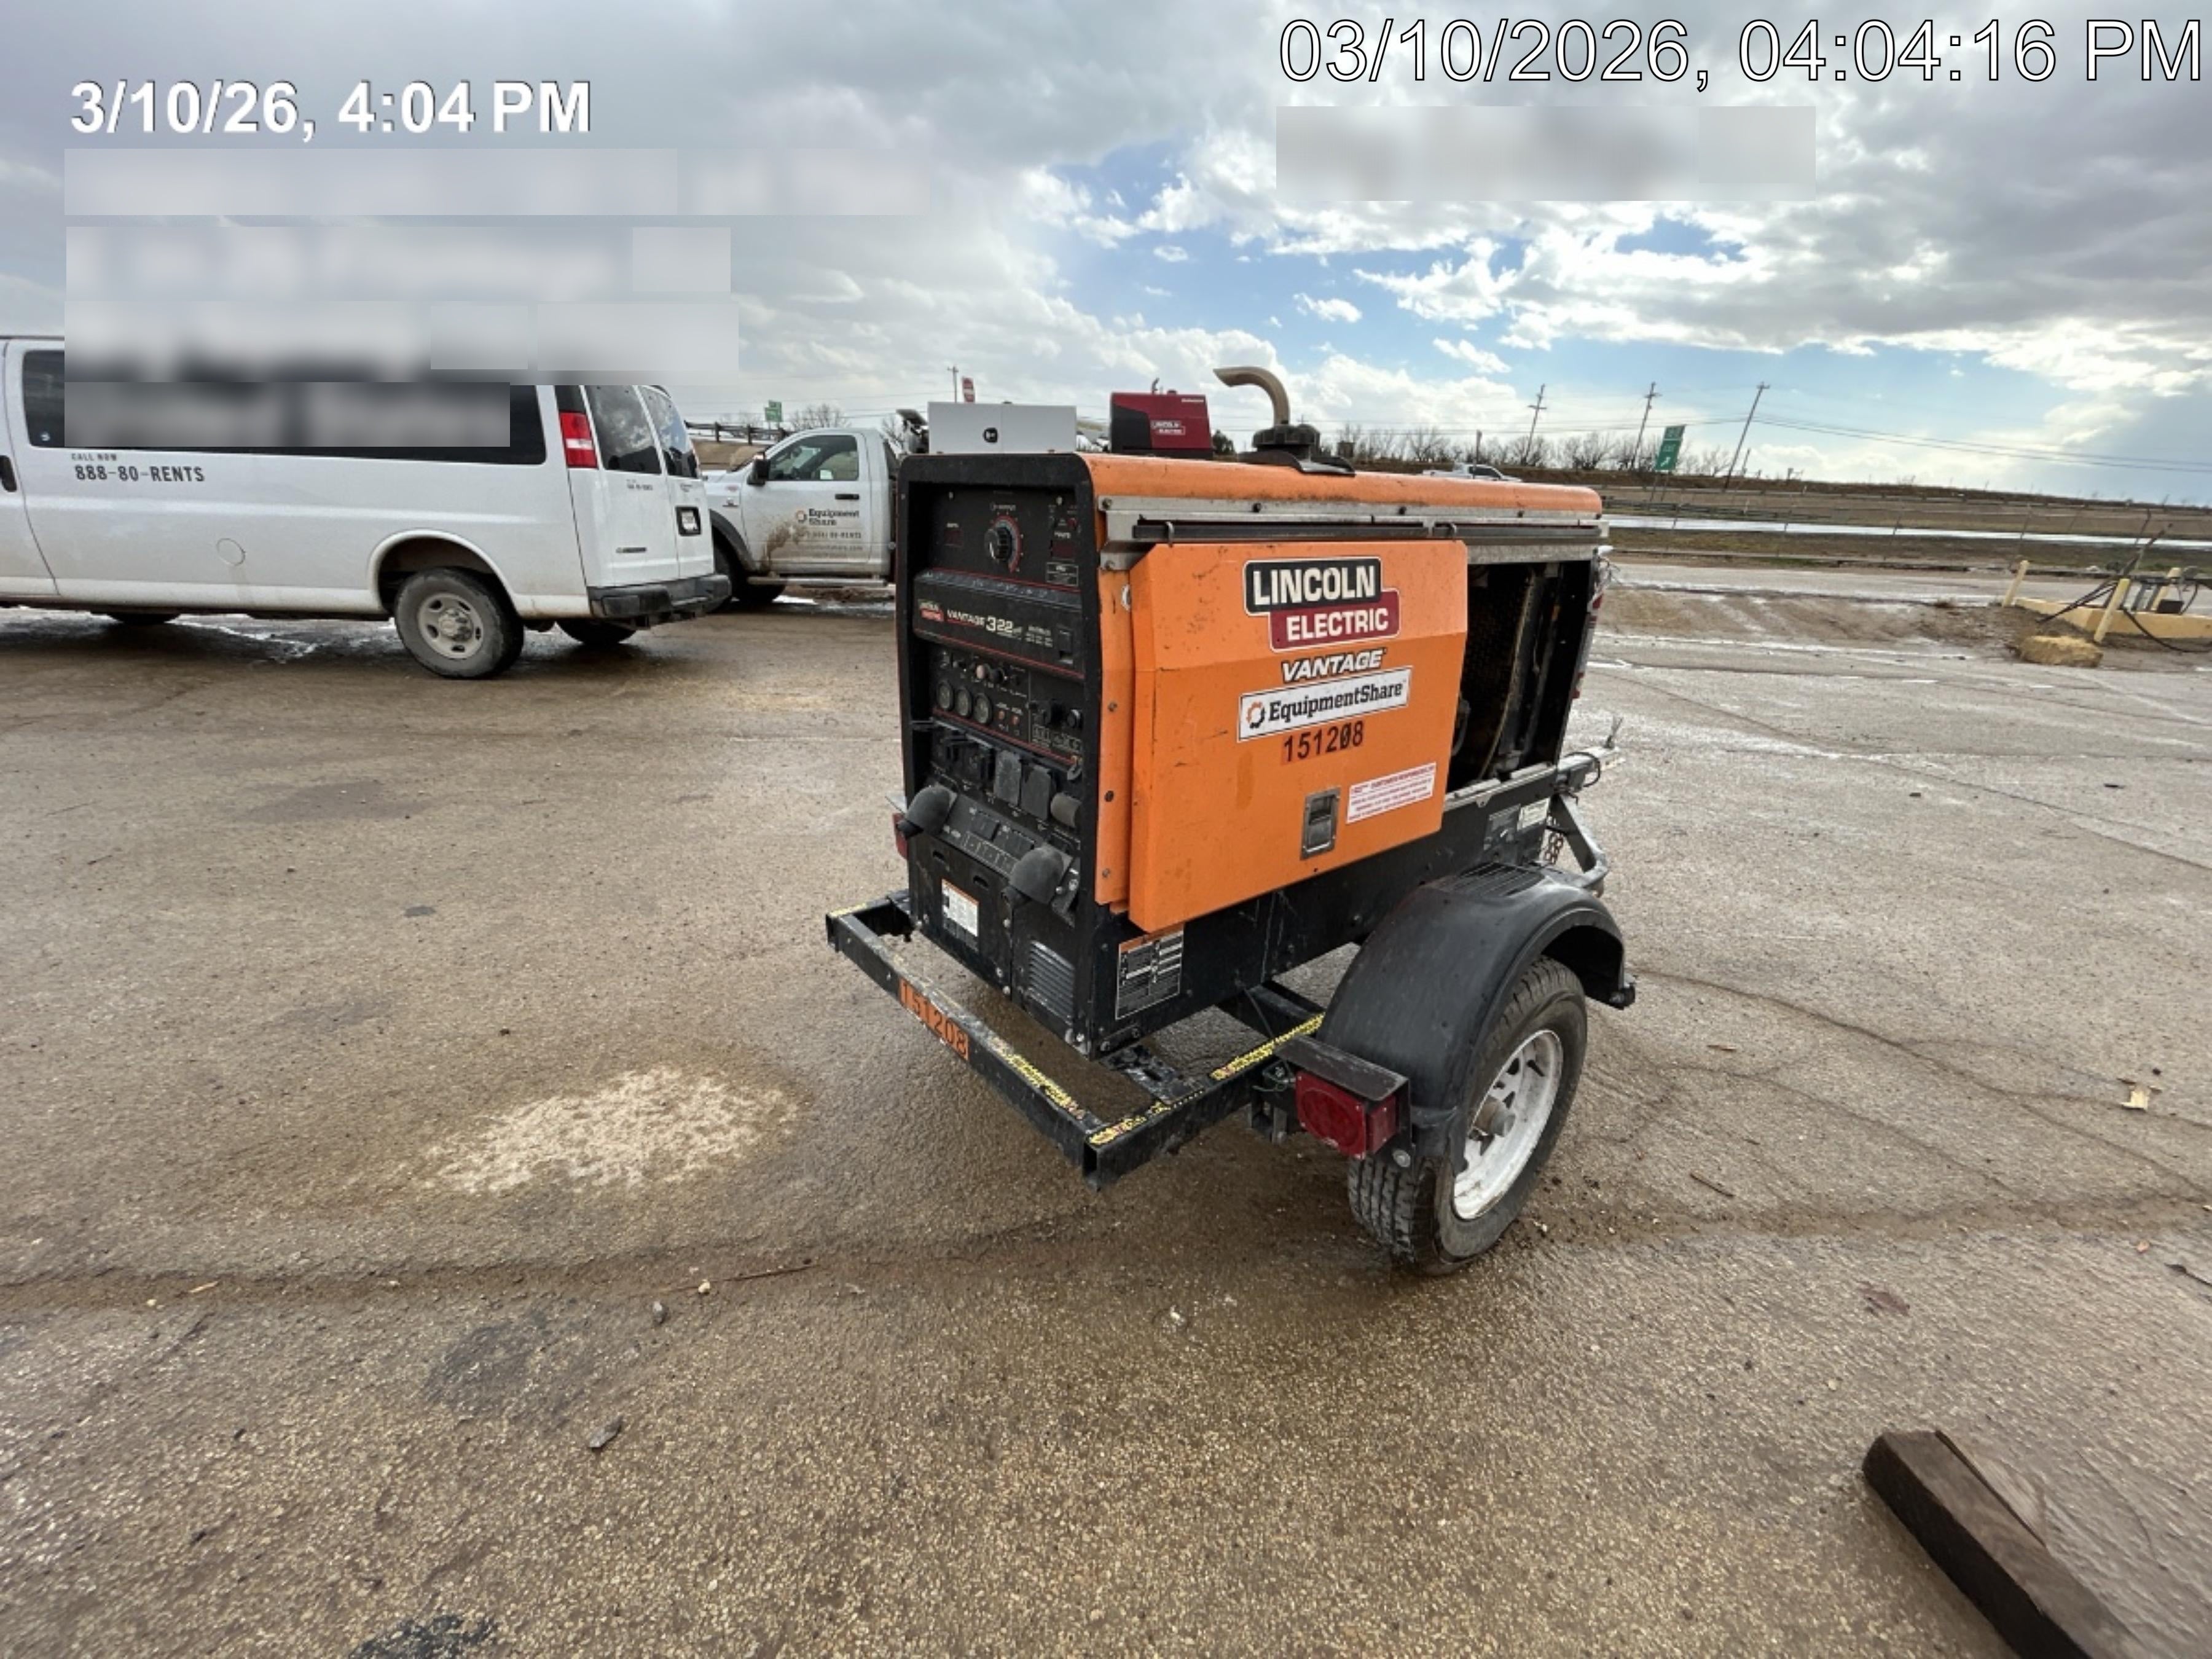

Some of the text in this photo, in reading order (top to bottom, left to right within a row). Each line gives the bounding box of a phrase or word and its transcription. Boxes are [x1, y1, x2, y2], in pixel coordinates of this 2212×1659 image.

[75, 465, 205, 482] 888-80-RENTS
[1253, 565, 1376, 606] LINCOLN
[985, 615, 1013, 633] 322
[1286, 607, 1389, 642] ELECTRIC
[1281, 648, 1384, 683] VANTAGE
[1268, 683, 1404, 723] EquipmentShare
[1284, 720, 1364, 762] 151208
